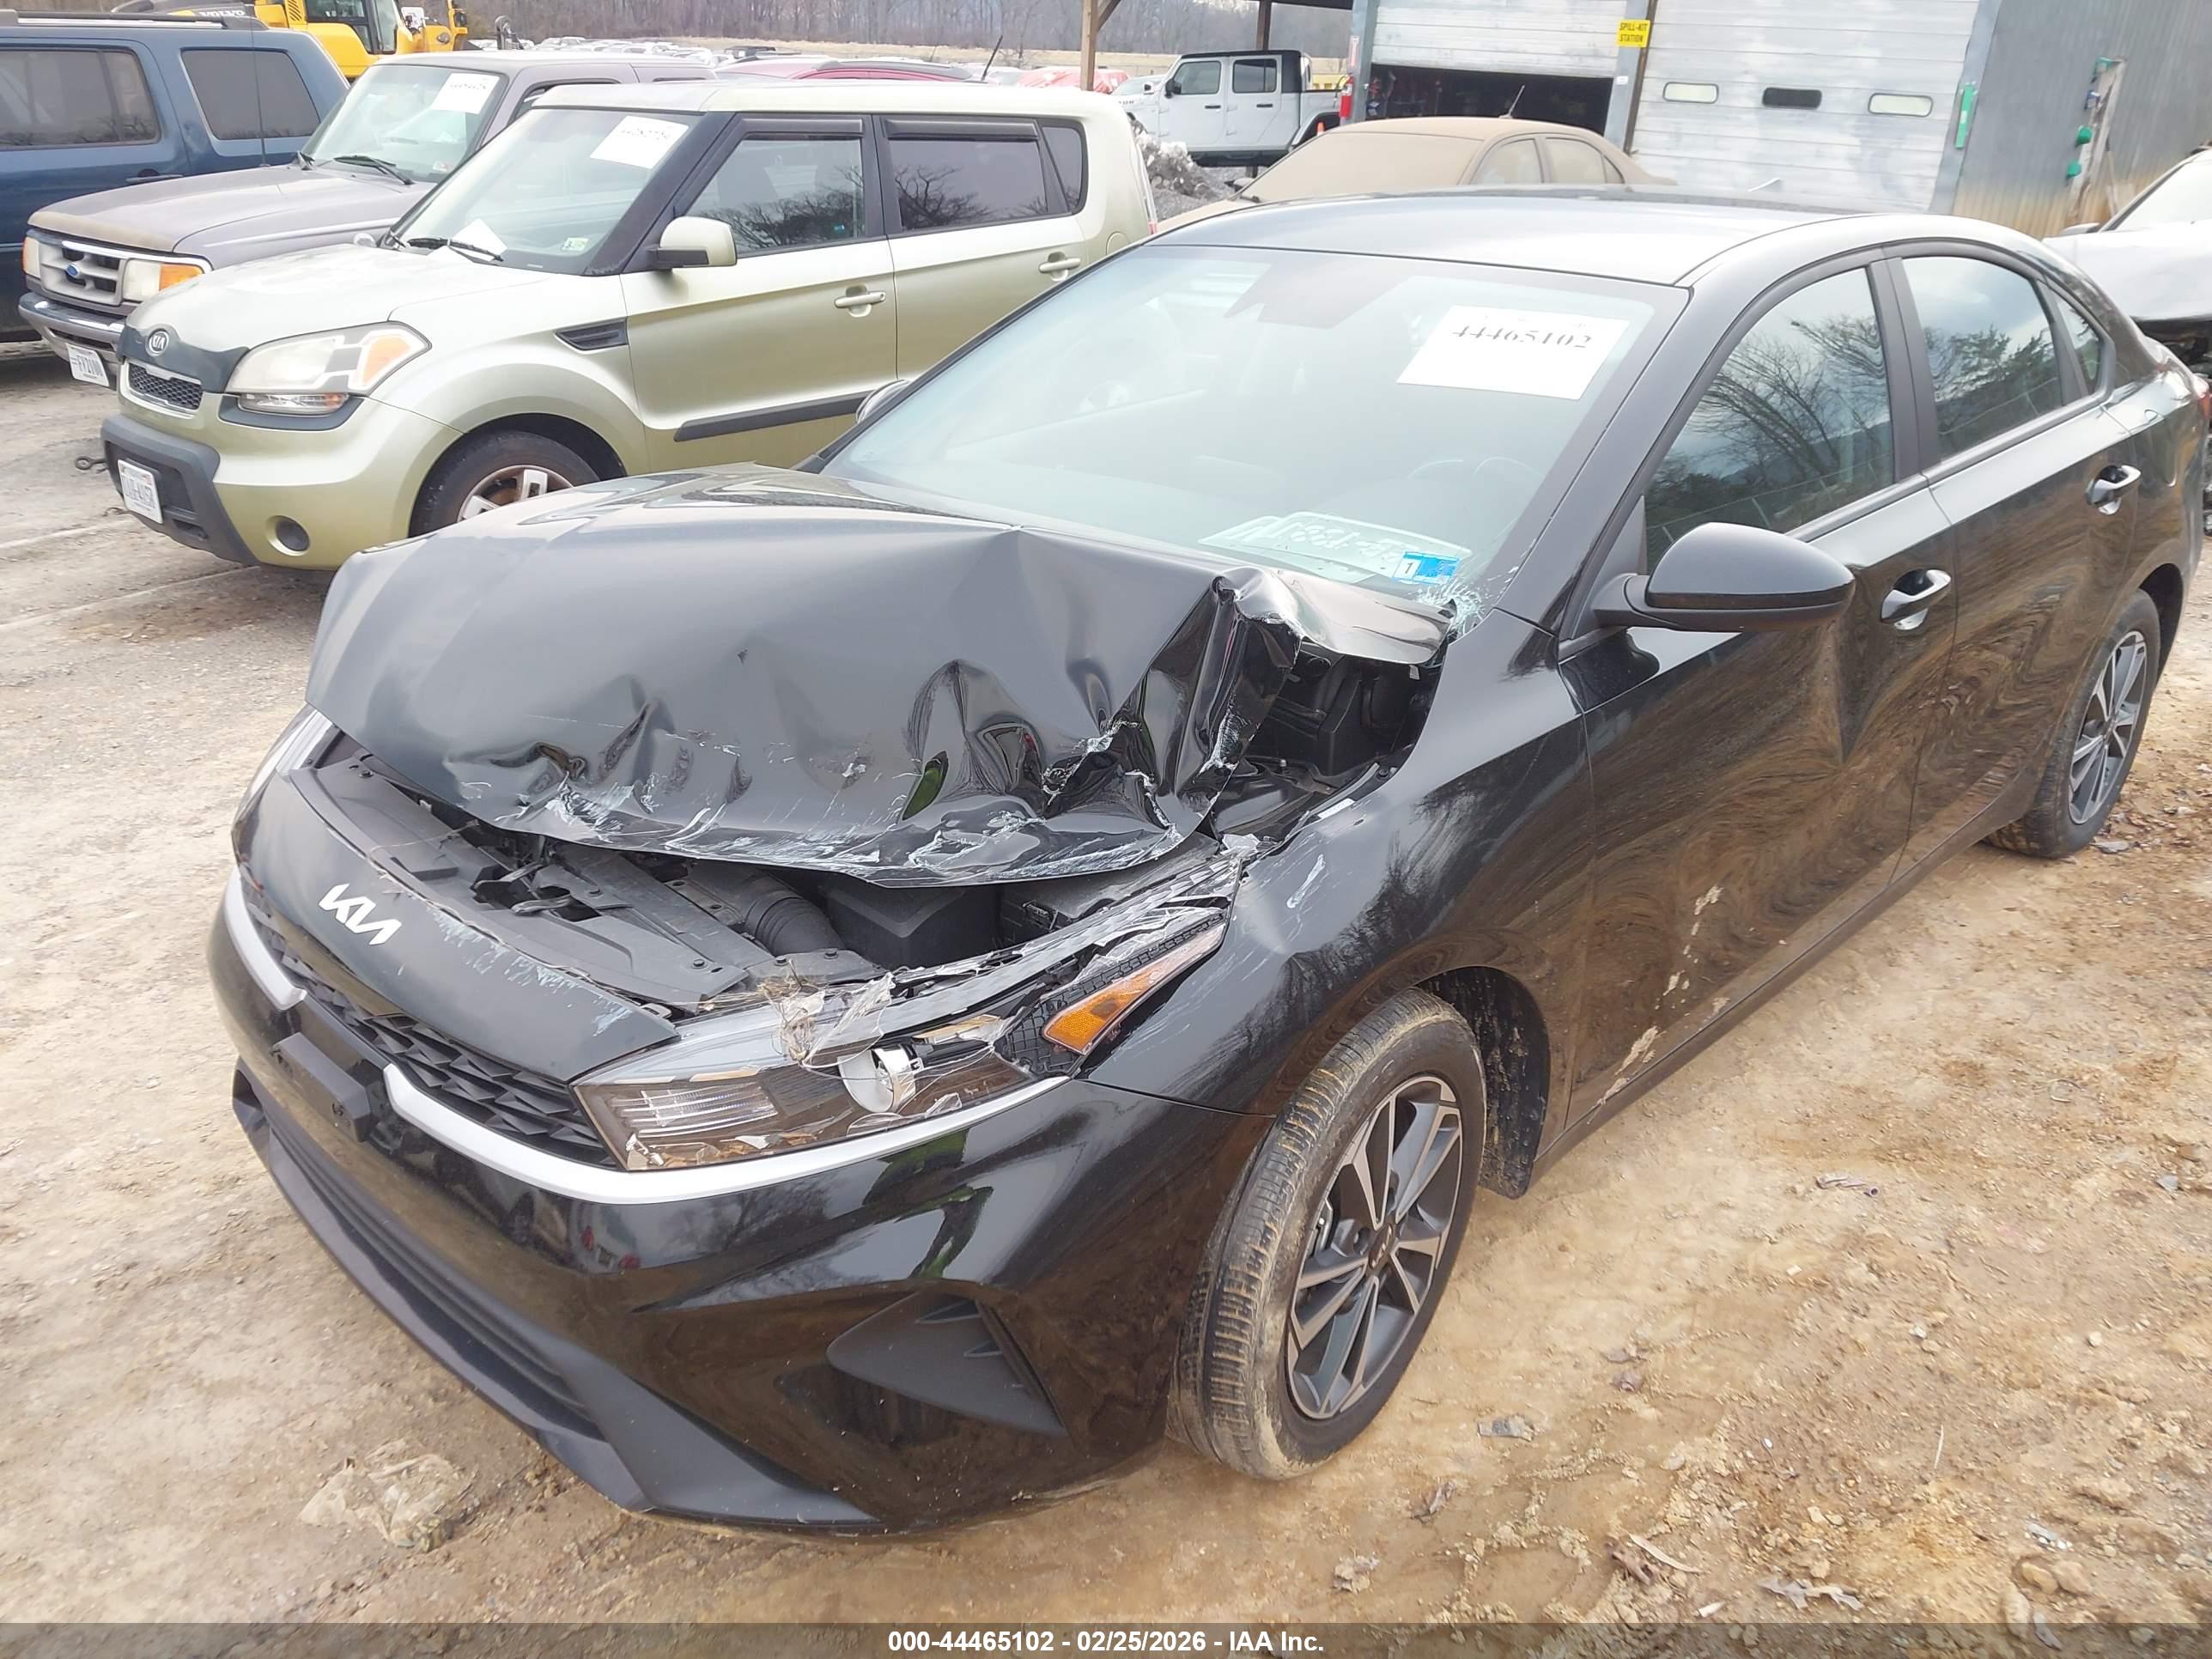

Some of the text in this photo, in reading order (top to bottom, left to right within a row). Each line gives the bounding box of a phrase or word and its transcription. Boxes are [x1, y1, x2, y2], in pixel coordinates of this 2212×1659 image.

[198, 9, 246, 18] VOLVO
[1620, 33, 1644, 43] STATION
[152, 335, 167, 349] KIA
[318, 883, 403, 945] KIA
